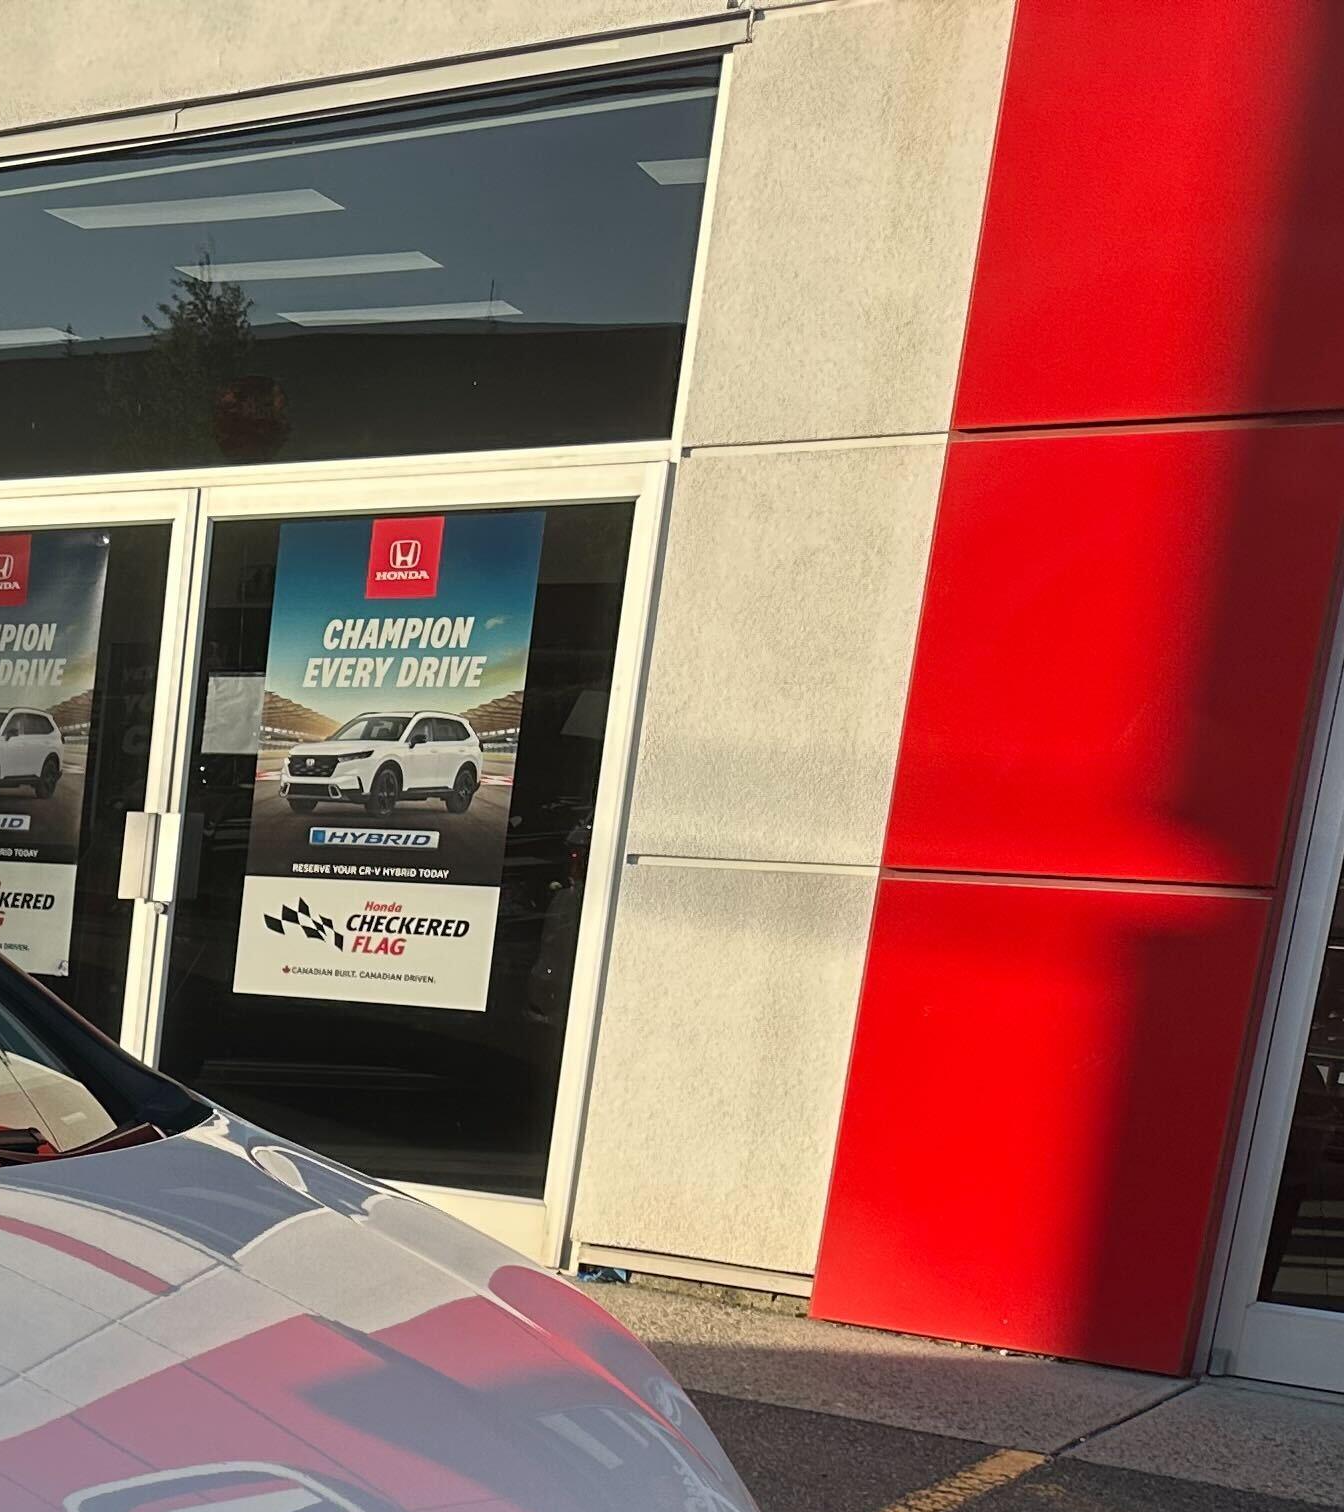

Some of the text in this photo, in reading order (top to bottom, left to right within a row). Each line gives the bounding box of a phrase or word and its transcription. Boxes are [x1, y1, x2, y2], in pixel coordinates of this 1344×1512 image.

[375, 570, 430, 581] HONDA
[323, 616, 475, 650] CHAMPION
[302, 655, 488, 688] EVERY DRIVE
[327, 831, 432, 846] HYBRID
[14, 848, 39, 858] TODAY
[292, 863, 450, 879] RESERVE YOUR CR-V HYBRID TODAY
[364, 900, 403, 913] Honda
[346, 913, 470, 938] CHECKERED
[351, 935, 408, 956] FLAG
[291, 966, 333, 977] CANADIAN
[359, 970, 402, 981] CANADIAN
[403, 973, 437, 984] DRIVEN.
